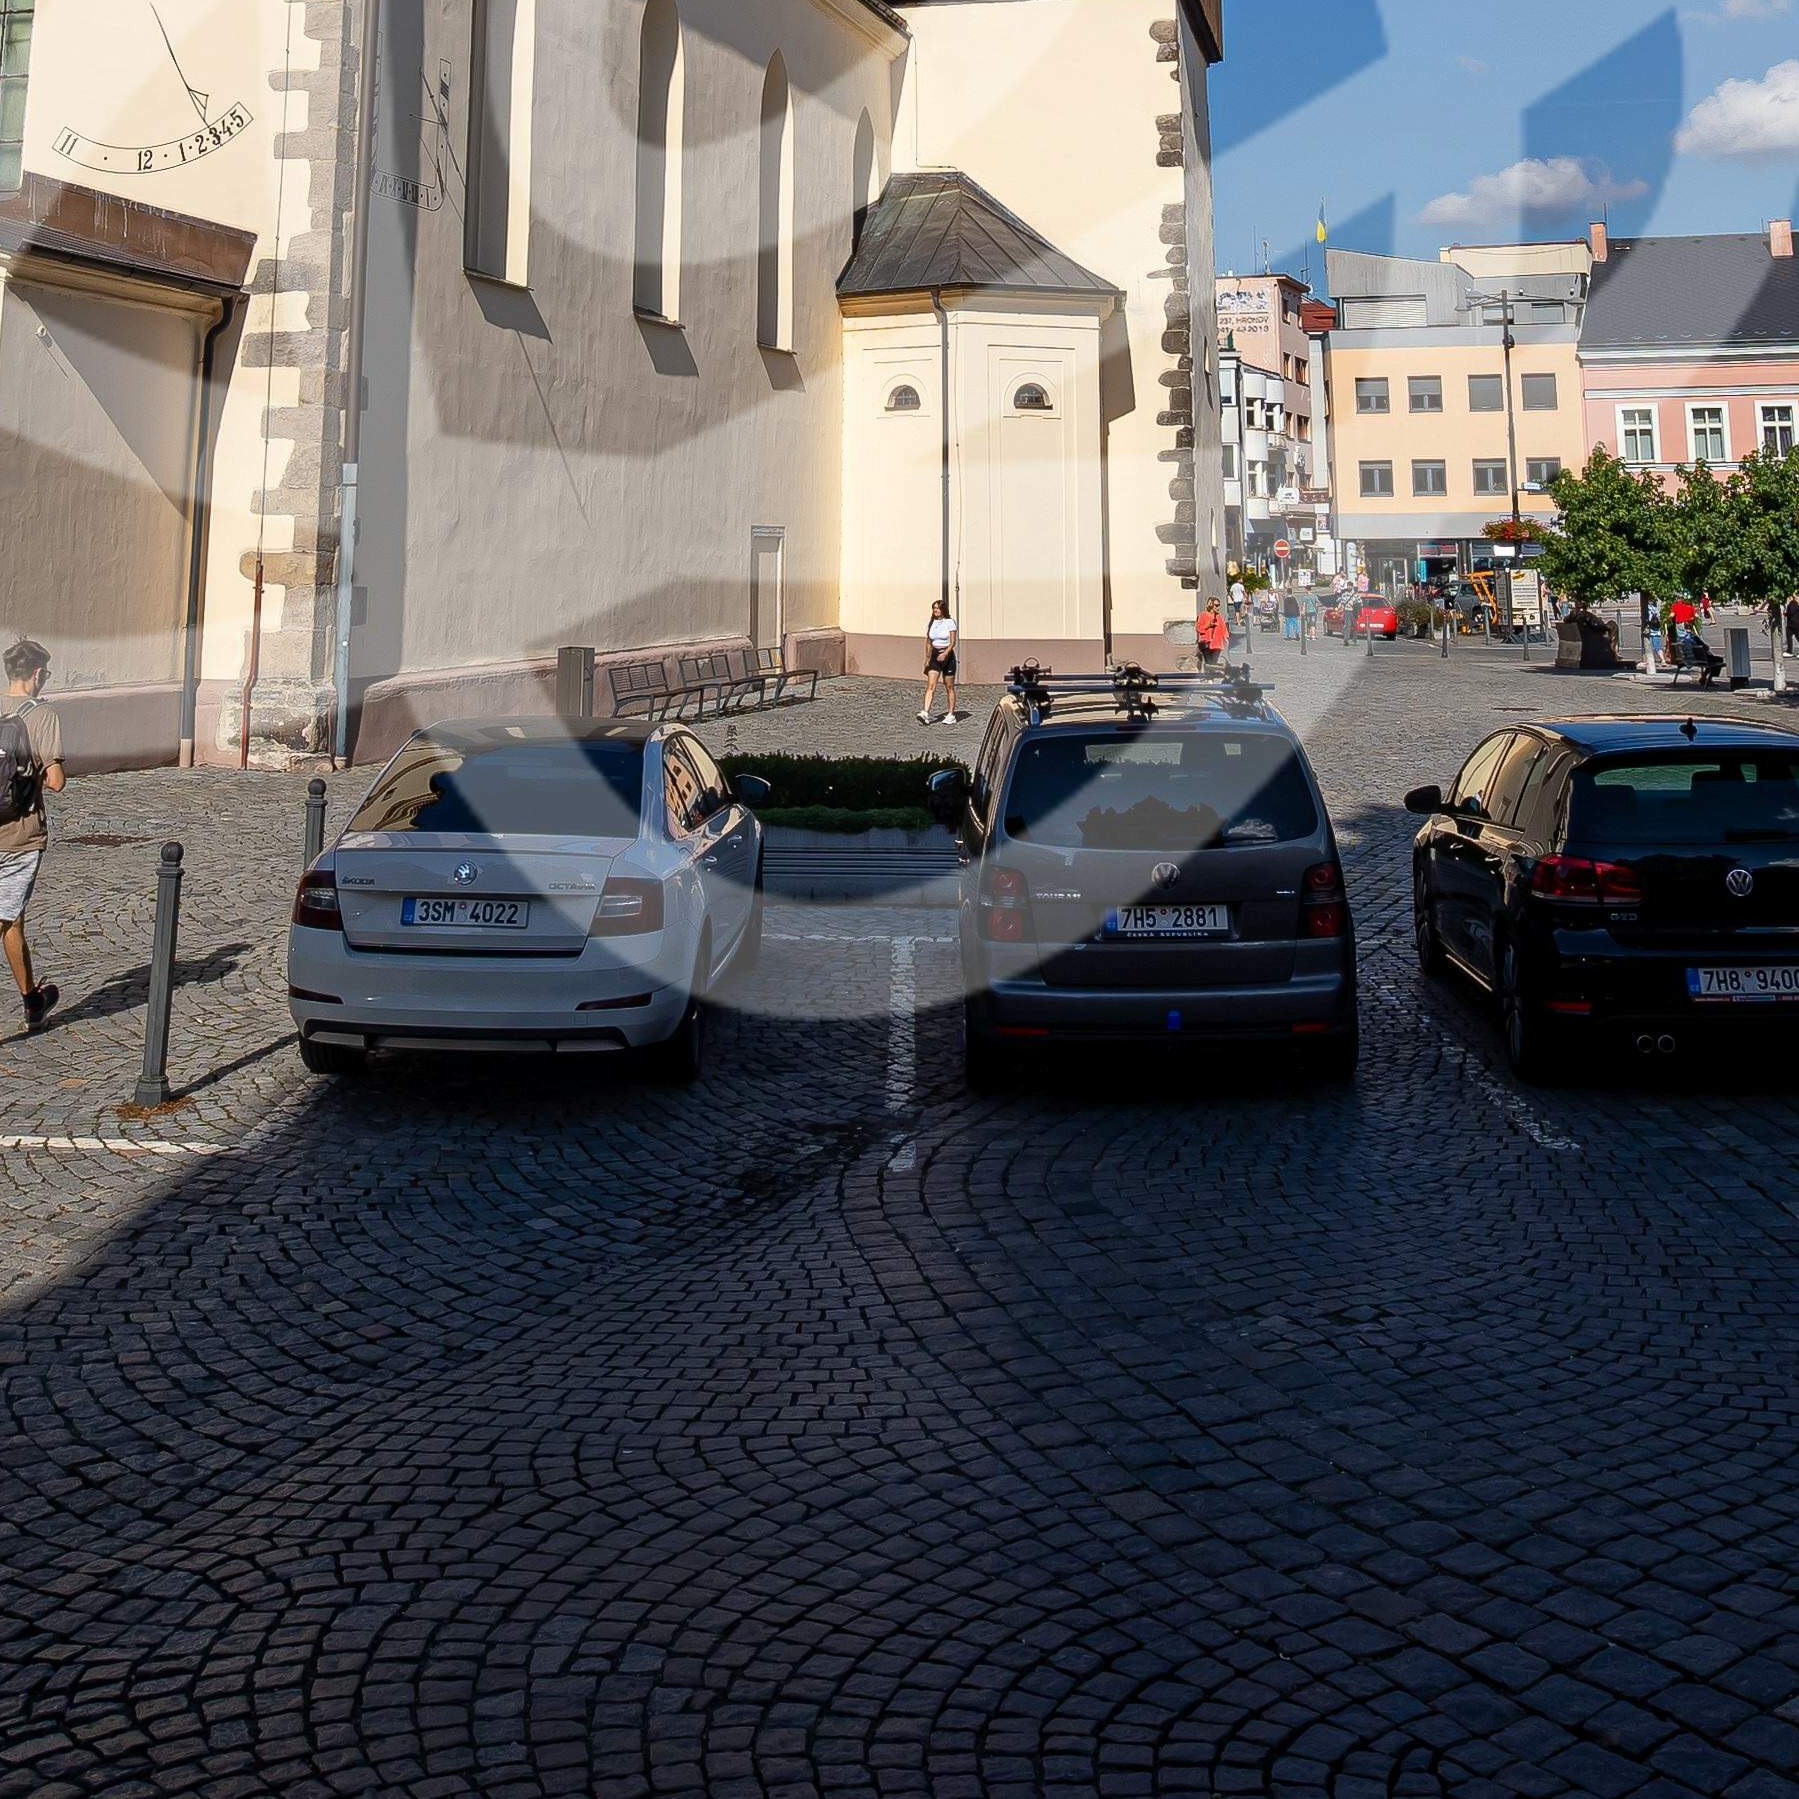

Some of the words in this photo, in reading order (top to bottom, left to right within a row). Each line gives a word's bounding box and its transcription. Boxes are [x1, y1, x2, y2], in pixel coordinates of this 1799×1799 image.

[137, 149, 153, 171] 12
[178, 142, 187, 162] 1
[195, 134, 208, 154] 2
[208, 126, 223, 147] 3
[221, 119, 233, 137] 4
[230, 109, 244, 128] 5
[418, 901, 456, 922] 3SM
[469, 902, 518, 924] 4022
[1120, 907, 1157, 929] 7H5
[1171, 906, 1218, 928] 2881
[1703, 970, 1741, 992] 7H8
